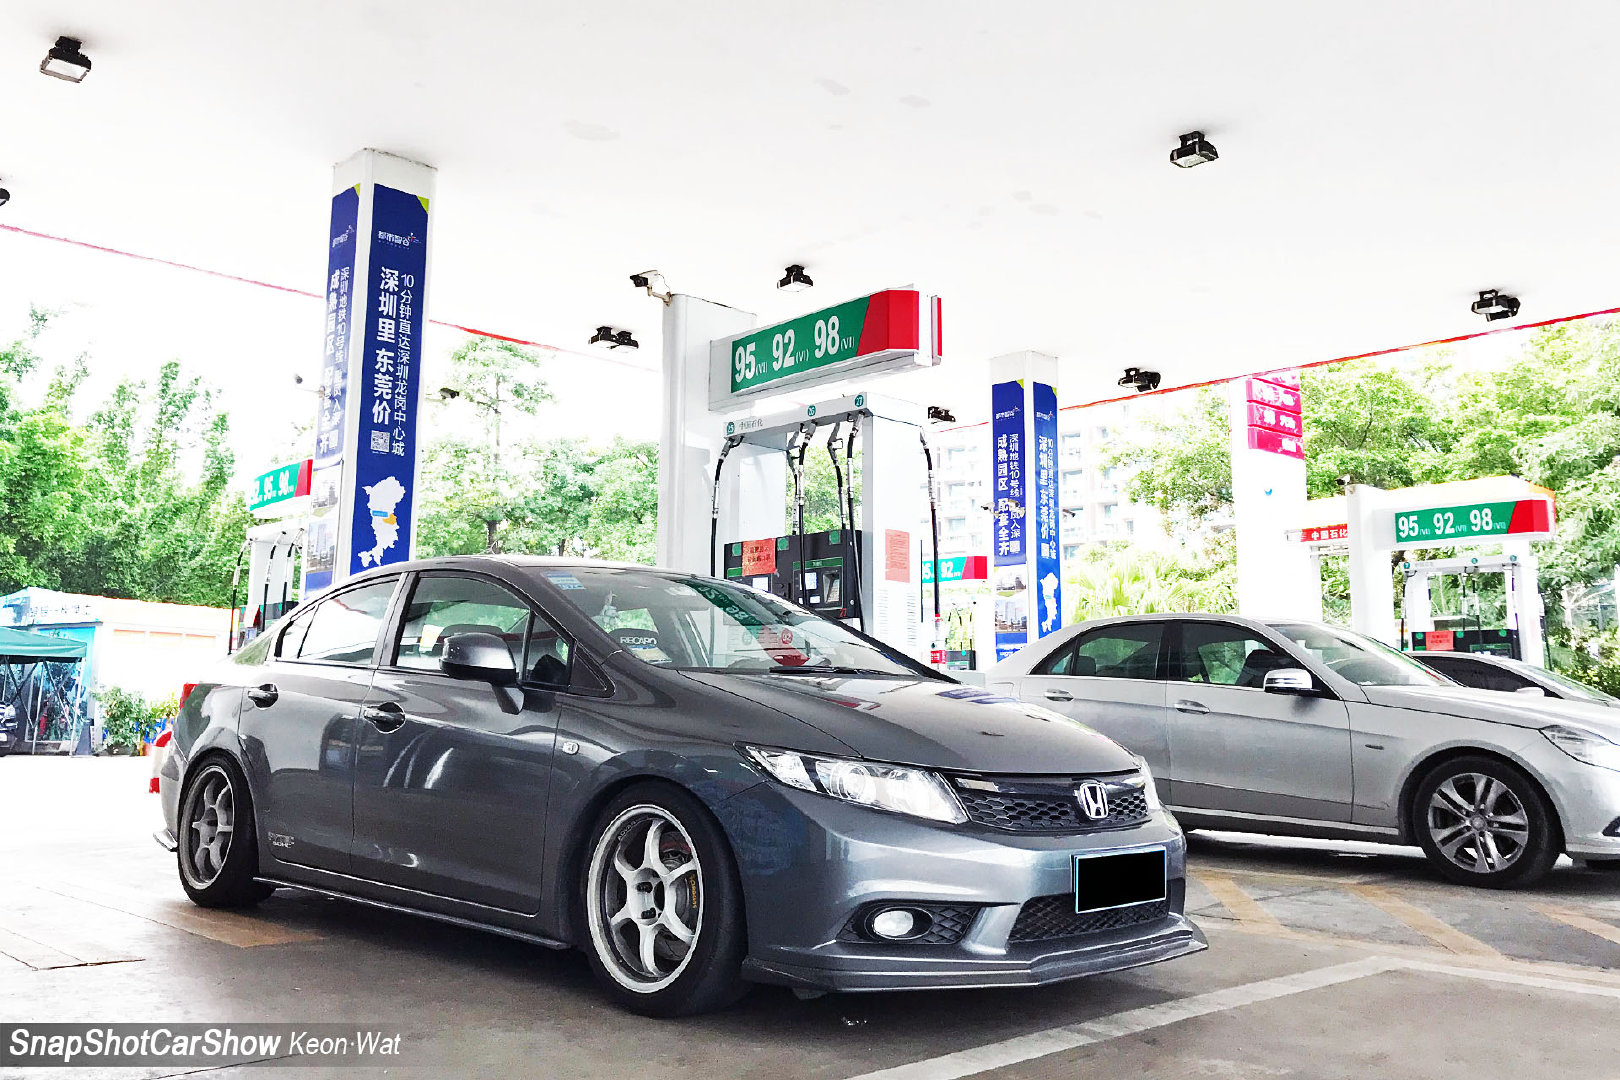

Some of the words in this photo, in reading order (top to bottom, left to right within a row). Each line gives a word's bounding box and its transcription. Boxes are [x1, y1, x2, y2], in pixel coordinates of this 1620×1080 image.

[376, 266, 399, 343] 深圳里
[372, 347, 395, 425] 东莞价
[391, 273, 414, 457] 10分钟直达深圳龙岗中心城
[735, 342, 756, 383] 95
[772, 329, 795, 371] 92
[814, 315, 840, 359] 98
[1398, 515, 1419, 538] 95
[1433, 512, 1455, 535] 92
[1469, 508, 1493, 531] 98
